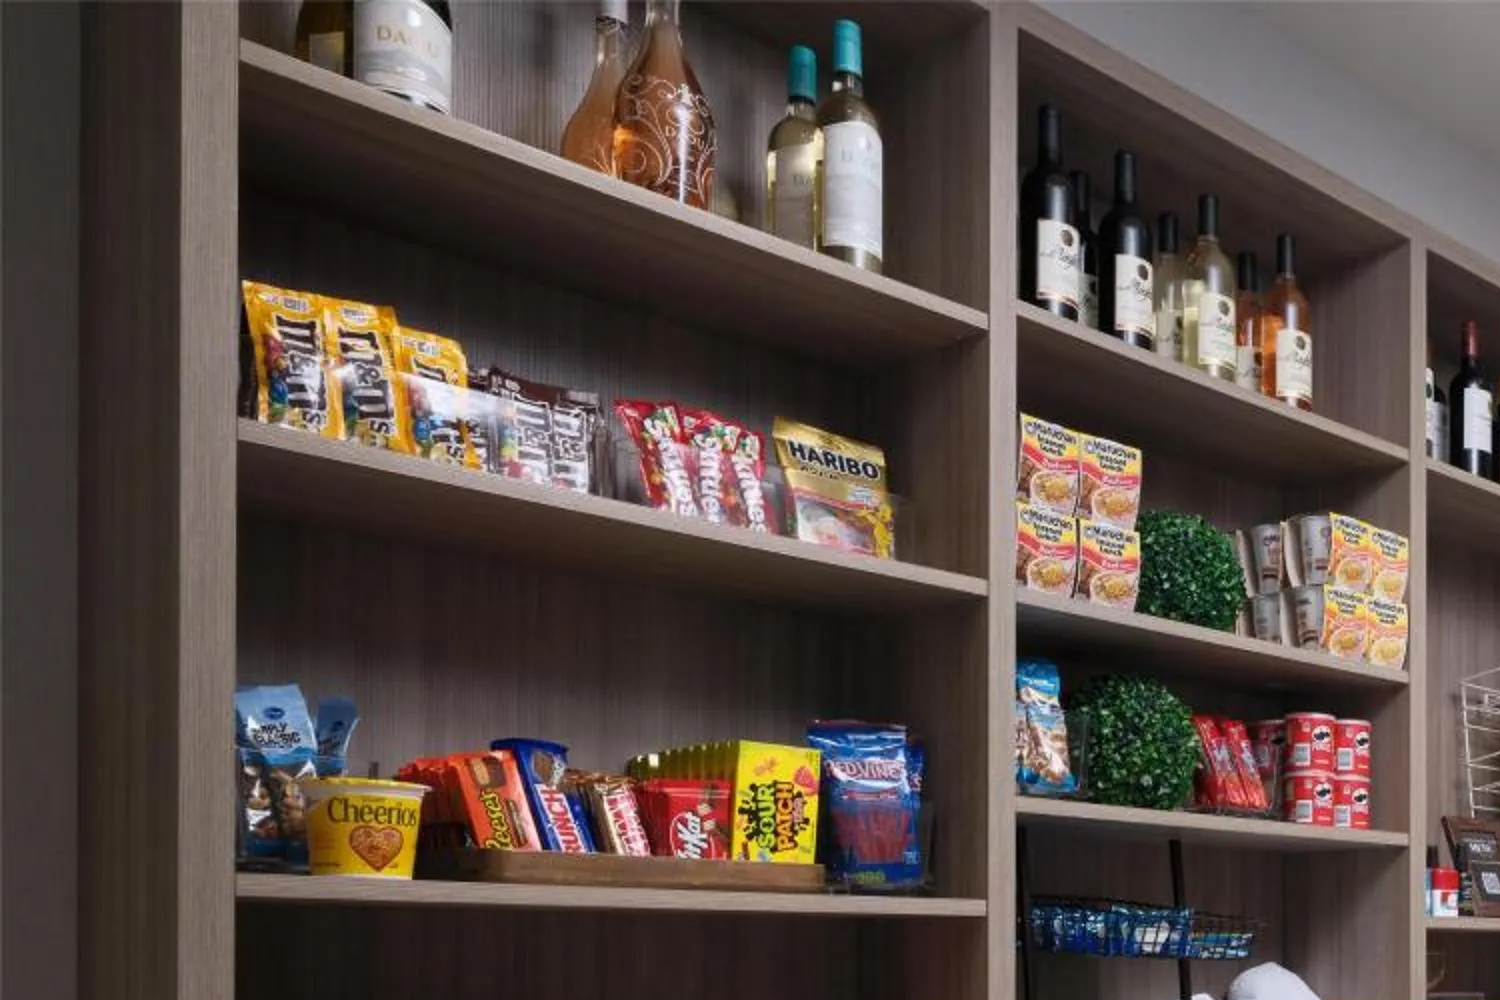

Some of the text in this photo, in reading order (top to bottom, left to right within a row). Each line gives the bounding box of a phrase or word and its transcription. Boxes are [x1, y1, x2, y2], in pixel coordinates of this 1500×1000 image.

[788, 440, 879, 479] HARIBO
[327, 797, 417, 827] Cheerios
[541, 787, 585, 853] RUNCH
[757, 783, 776, 849] SOUR
[776, 780, 799, 850] PATCH
